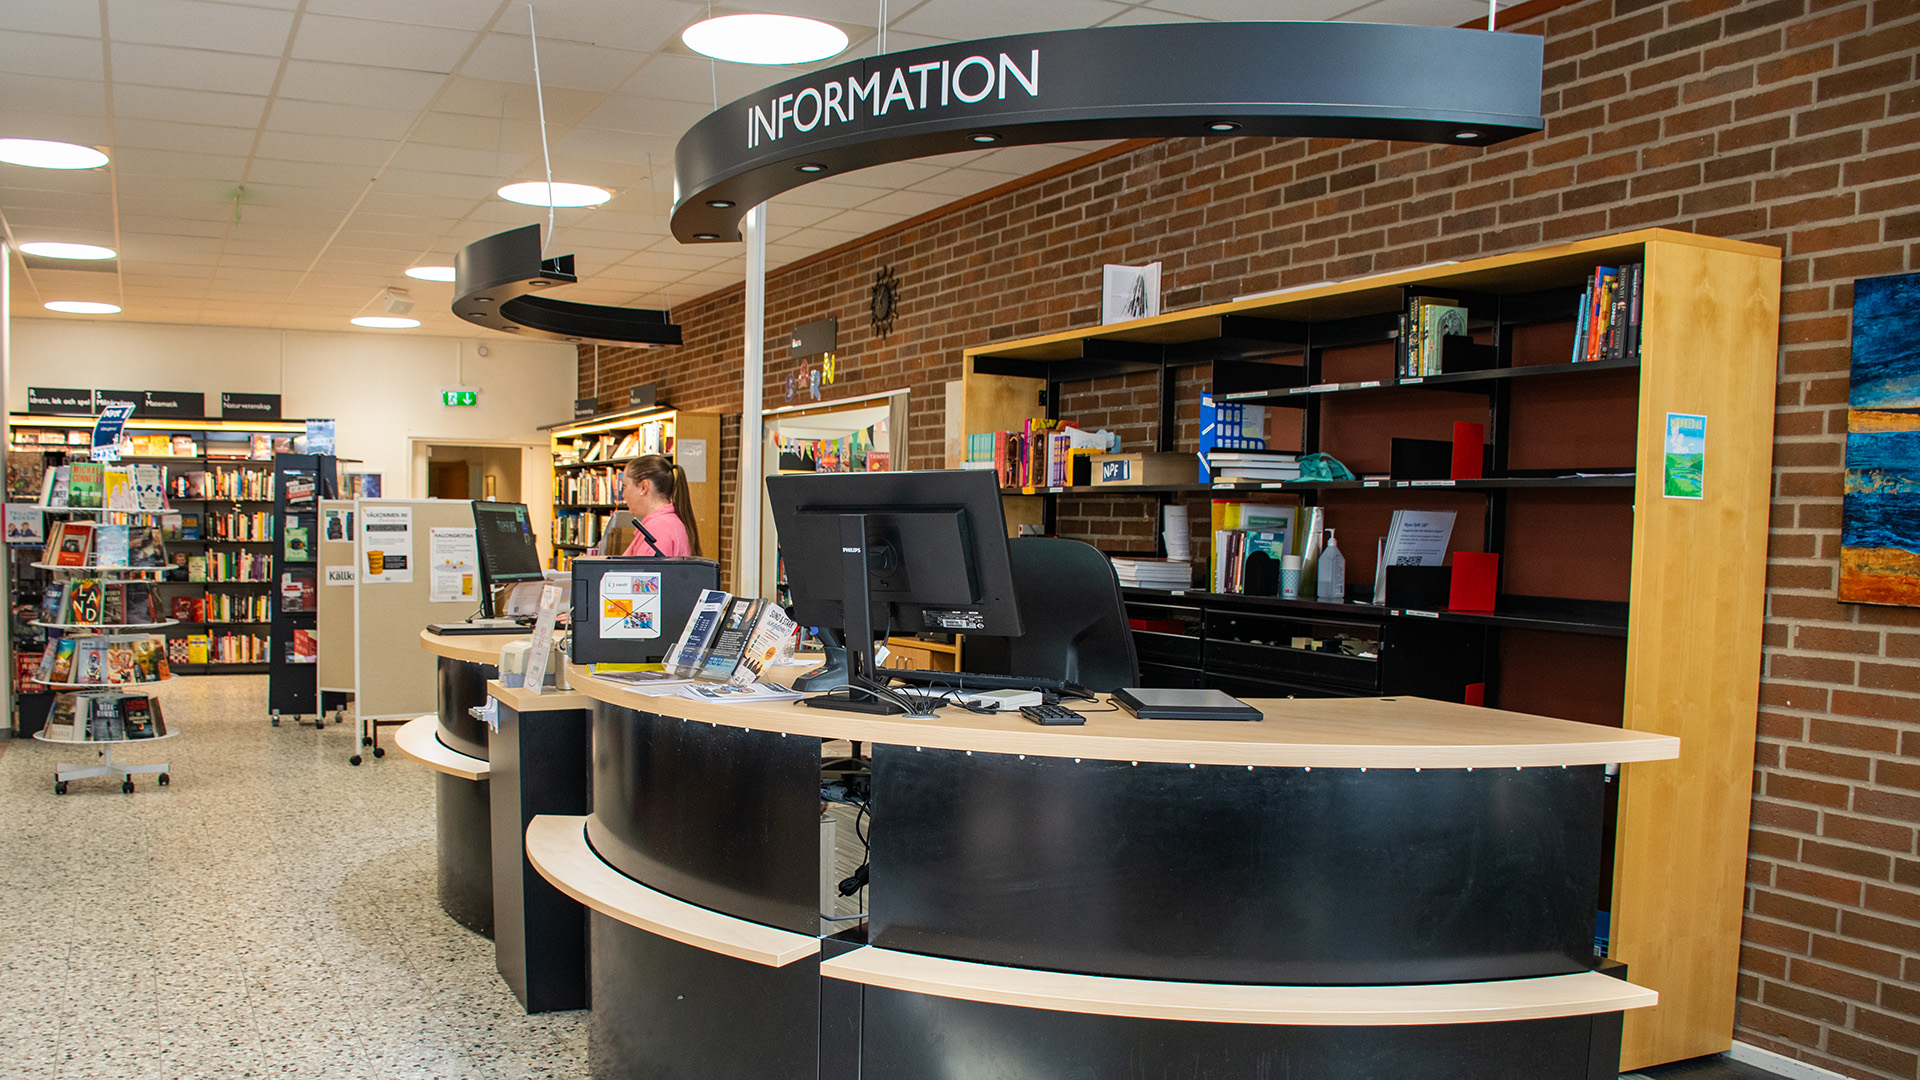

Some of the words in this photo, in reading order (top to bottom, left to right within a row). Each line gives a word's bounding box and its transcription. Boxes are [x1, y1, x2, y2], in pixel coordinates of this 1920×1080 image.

[747, 49, 1039, 149] INFORMATION
[785, 352, 836, 402] BARN
[29, 389, 36, 397] R
[96, 391, 102, 399] S
[145, 391, 152, 400] T
[223, 394, 230, 402] U
[145, 400, 178, 408] Matematik
[223, 402, 272, 411] Naturvetenskap
[1670, 417, 1702, 429] MUNKEDAL
[72, 465, 103, 476] MICHAEL
[1103, 462, 1120, 479] NPF
[769, 609, 781, 621] SUND
